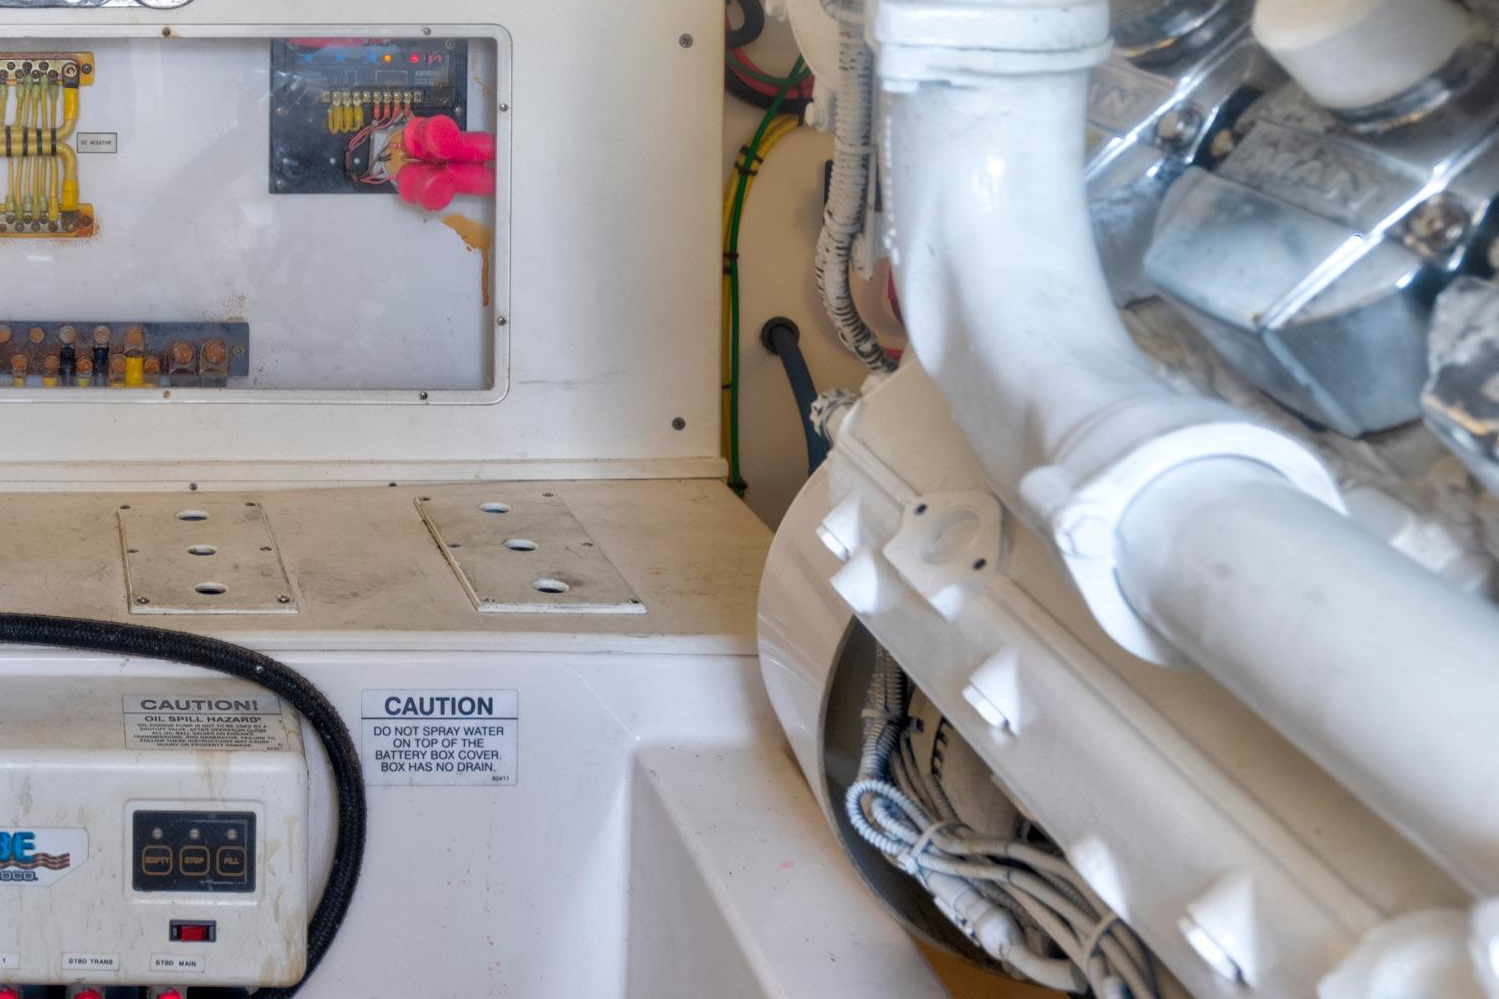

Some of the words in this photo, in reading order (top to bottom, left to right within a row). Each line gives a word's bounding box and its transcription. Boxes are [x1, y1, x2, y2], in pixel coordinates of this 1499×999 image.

[141, 700, 259, 711] CAUTION!
[385, 696, 493, 716] CAUTION
[373, 726, 391, 736] DO
[394, 726, 419, 736] NOT
[422, 726, 461, 736] SPRAY
[463, 726, 504, 736] WATER
[393, 738, 410, 748] ON
[413, 738, 438, 748] TOP
[441, 738, 457, 748] OF
[461, 738, 484, 748] THE
[375, 750, 427, 760] BATTERY
[430, 750, 455, 760] BOX
[458, 750, 501, 760] COVER.
[381, 762, 405, 772] BOX
[408, 762, 432, 772] HAS
[436, 762, 453, 772] NO
[457, 762, 496, 773] DRAIN.
